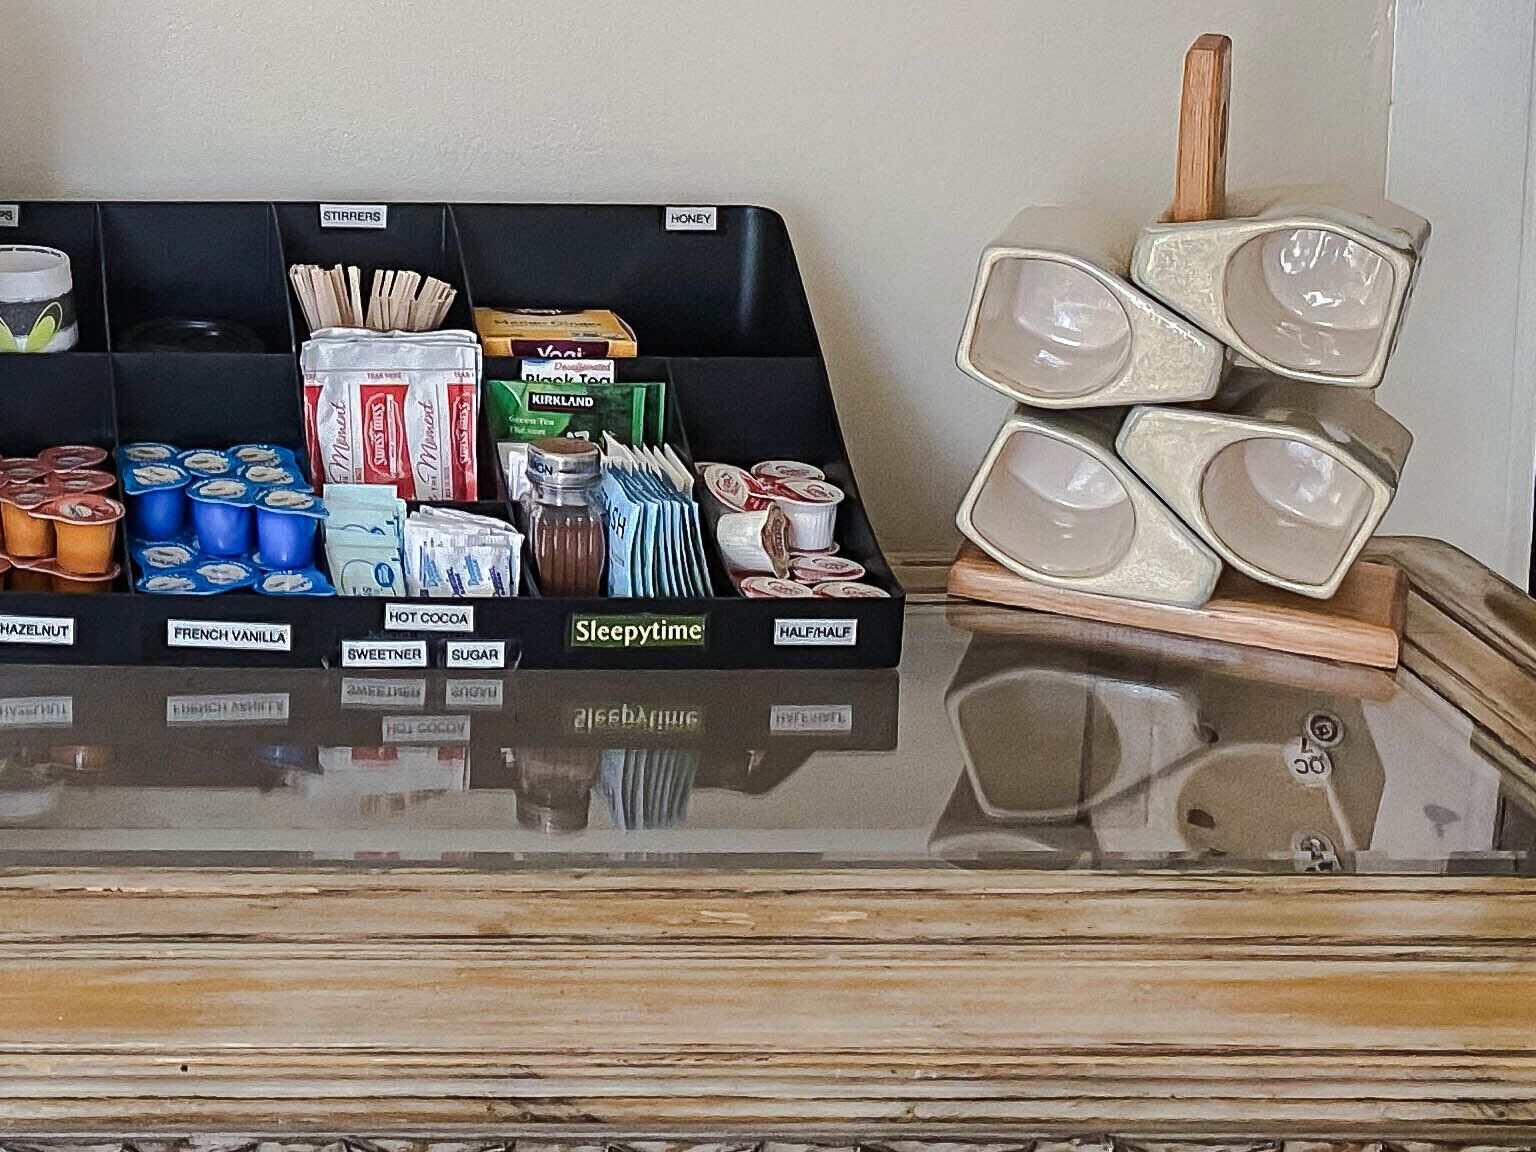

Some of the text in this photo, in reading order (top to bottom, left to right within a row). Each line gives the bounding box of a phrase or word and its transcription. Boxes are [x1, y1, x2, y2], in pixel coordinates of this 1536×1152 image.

[322, 209, 381, 223] STIRRERS
[671, 212, 712, 225] HONEY
[525, 373, 612, 384] Black Tea
[531, 393, 594, 408] KIRKLAND
[329, 399, 351, 484] Moment
[416, 399, 438, 484] Moment
[389, 611, 469, 625] HOT COCOA
[0, 622, 69, 638] HAZELNUT
[173, 626, 286, 644] FRENCH VANILLA
[575, 619, 703, 647] Sleepytime
[779, 625, 852, 639] HALF/HALF
[347, 648, 422, 661] SWEETNER
[451, 648, 499, 661] SUGAR
